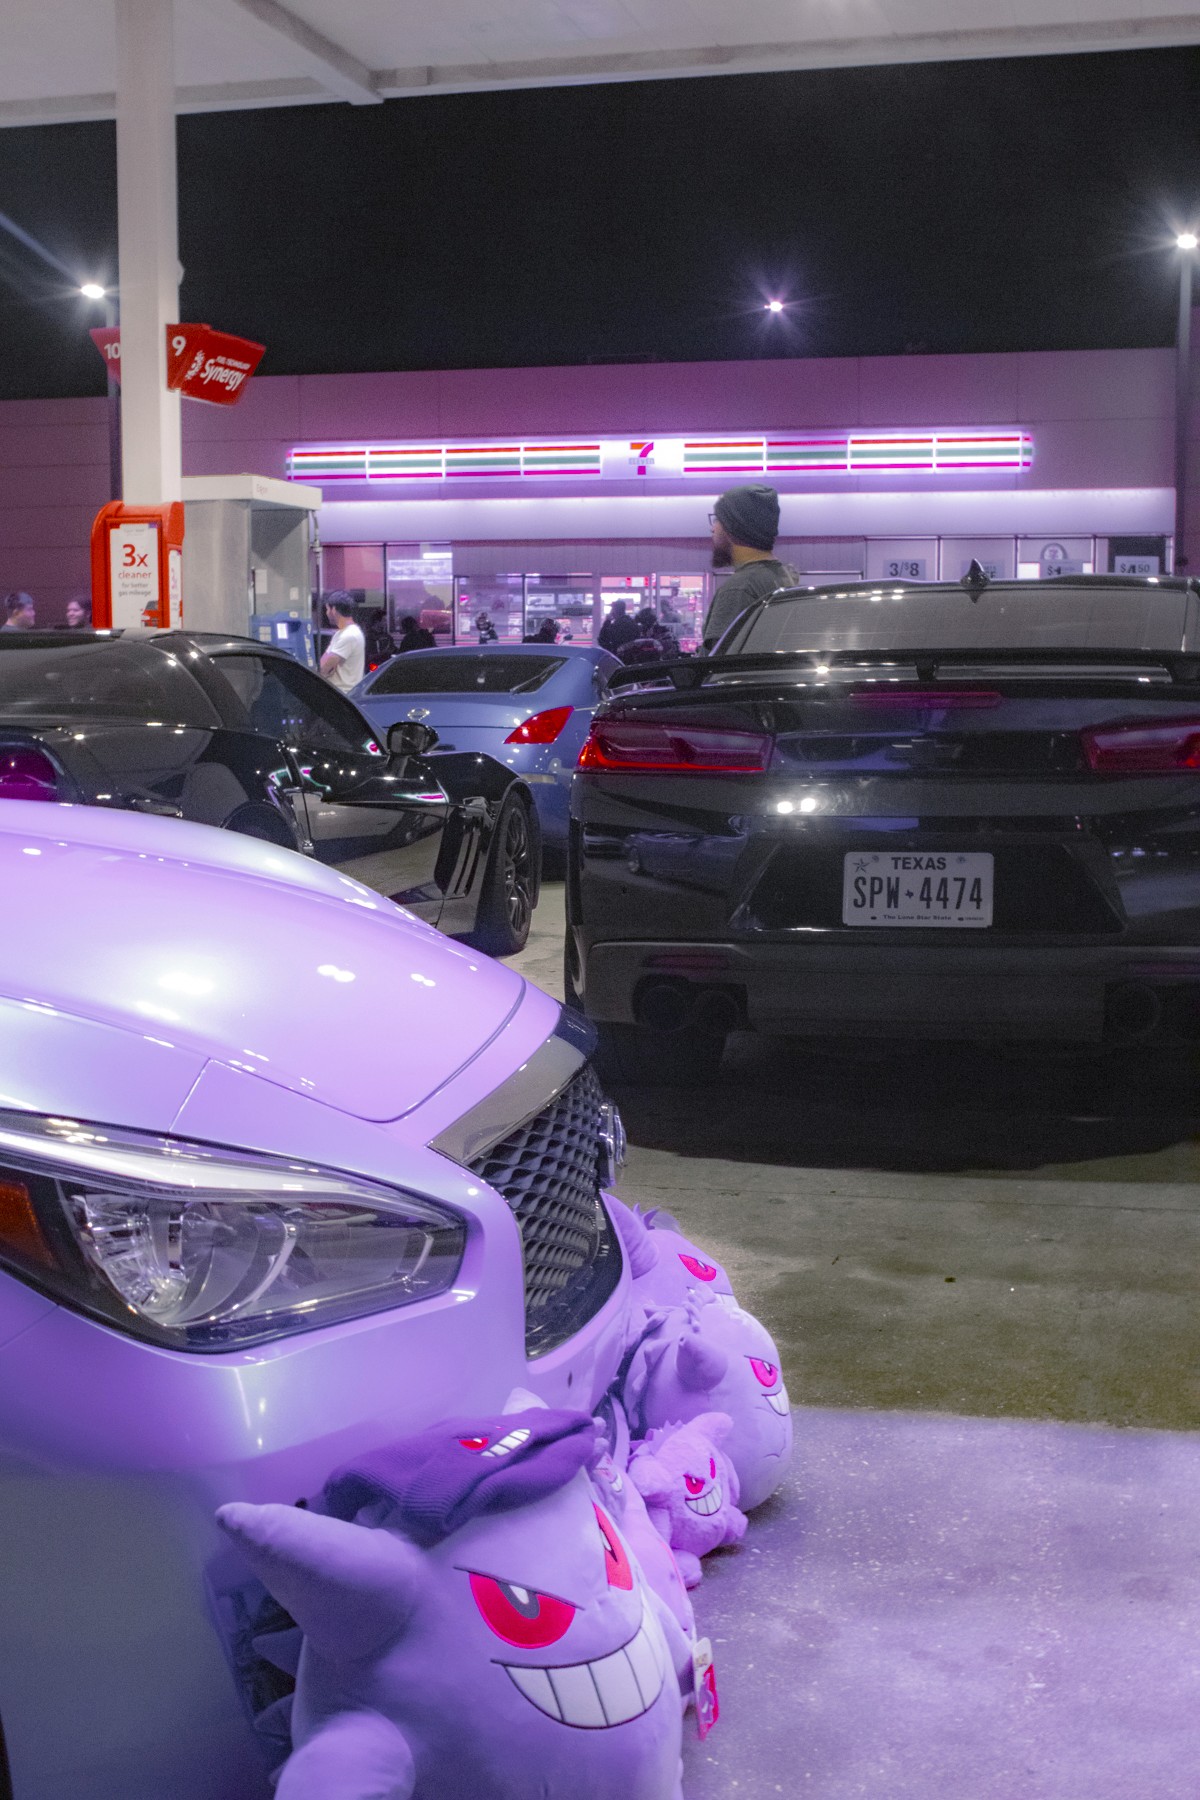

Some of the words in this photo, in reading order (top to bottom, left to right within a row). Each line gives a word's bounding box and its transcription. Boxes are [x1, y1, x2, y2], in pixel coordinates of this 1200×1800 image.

[104, 342, 121, 360] 10
[171, 335, 187, 357] 9
[199, 358, 246, 392] Synergy
[630, 441, 654, 476] 7
[122, 543, 148, 567] 3x
[118, 571, 151, 579] cleaner
[891, 856, 947, 871] TEXAS
[853, 876, 900, 909] SPW
[919, 876, 983, 910] 4474
